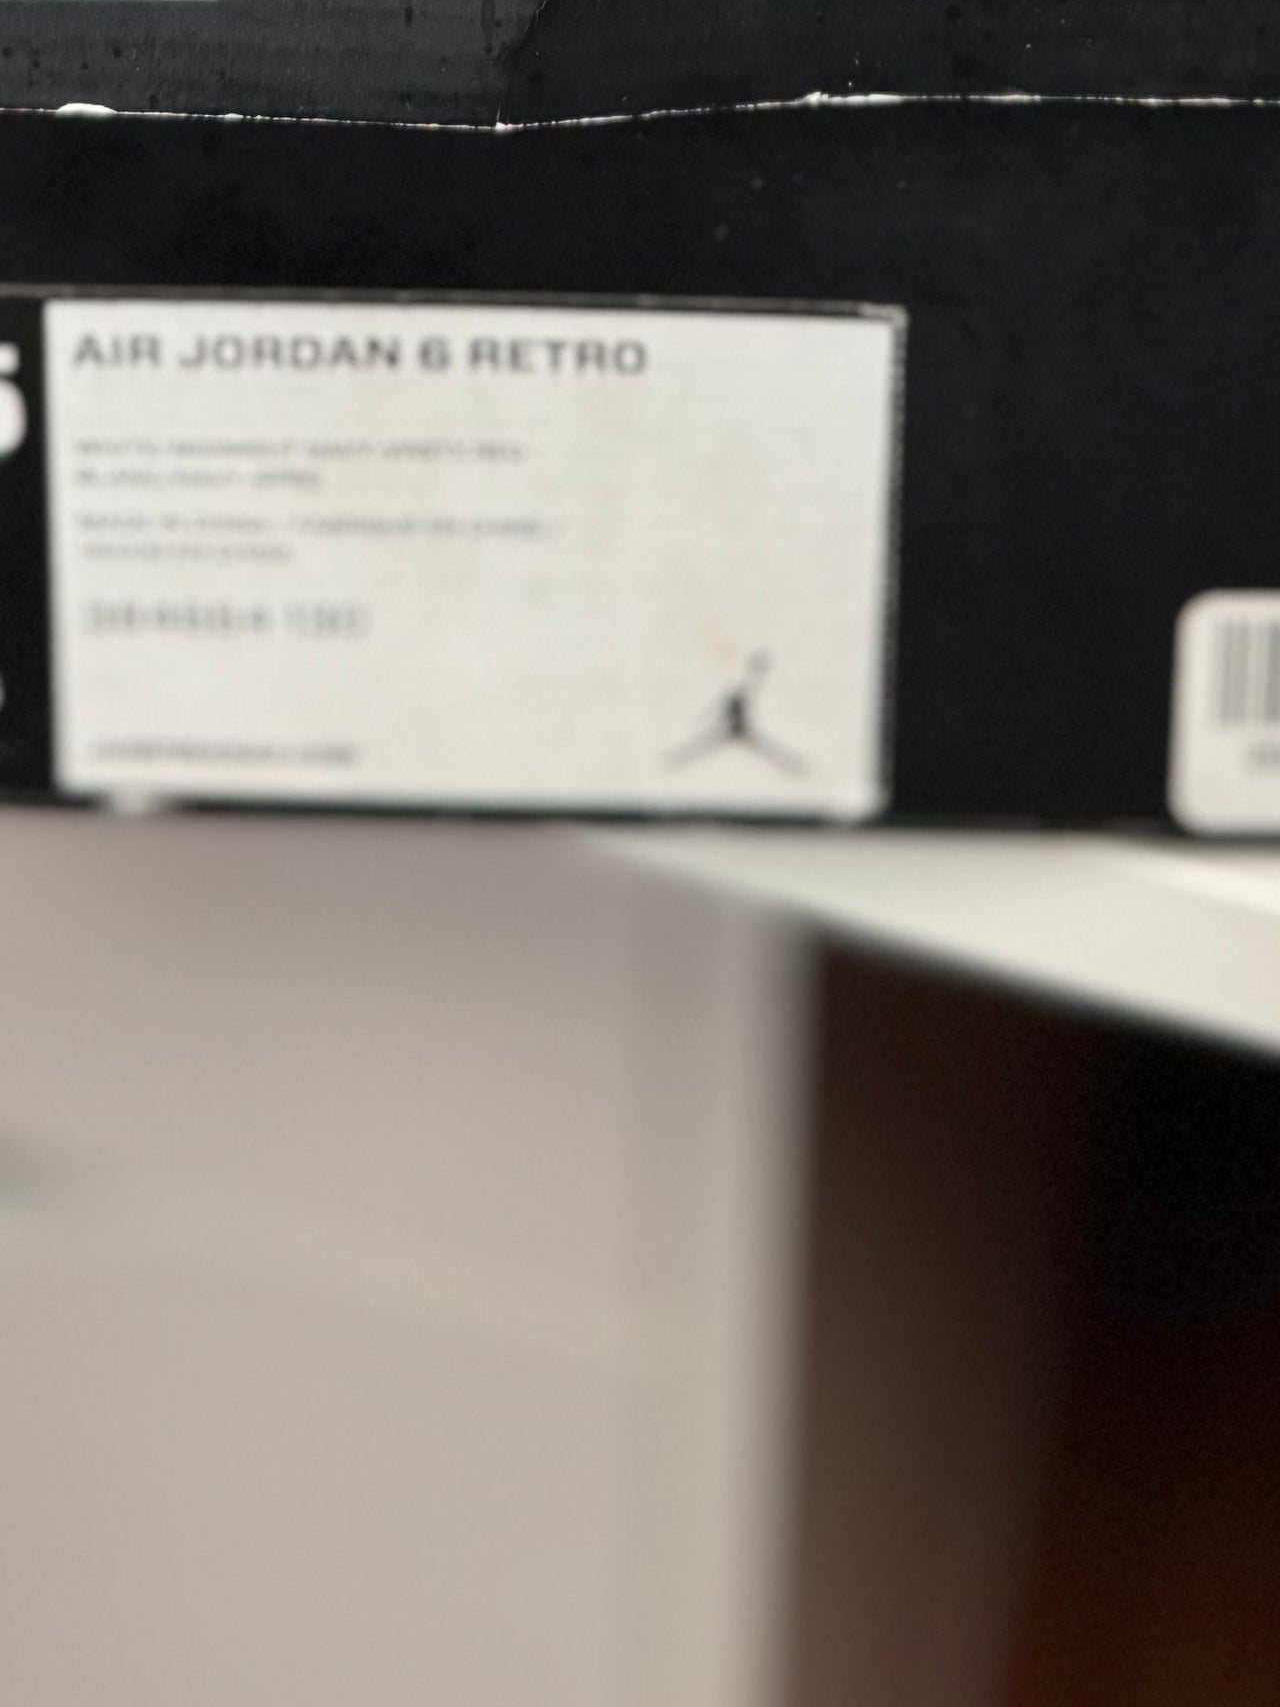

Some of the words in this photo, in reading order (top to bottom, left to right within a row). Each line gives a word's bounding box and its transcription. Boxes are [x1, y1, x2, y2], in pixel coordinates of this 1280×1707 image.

[72, 334, 162, 371] AIR
[177, 335, 402, 372] JORDAN
[420, 337, 451, 373] 6
[467, 337, 649, 376] RETRO
